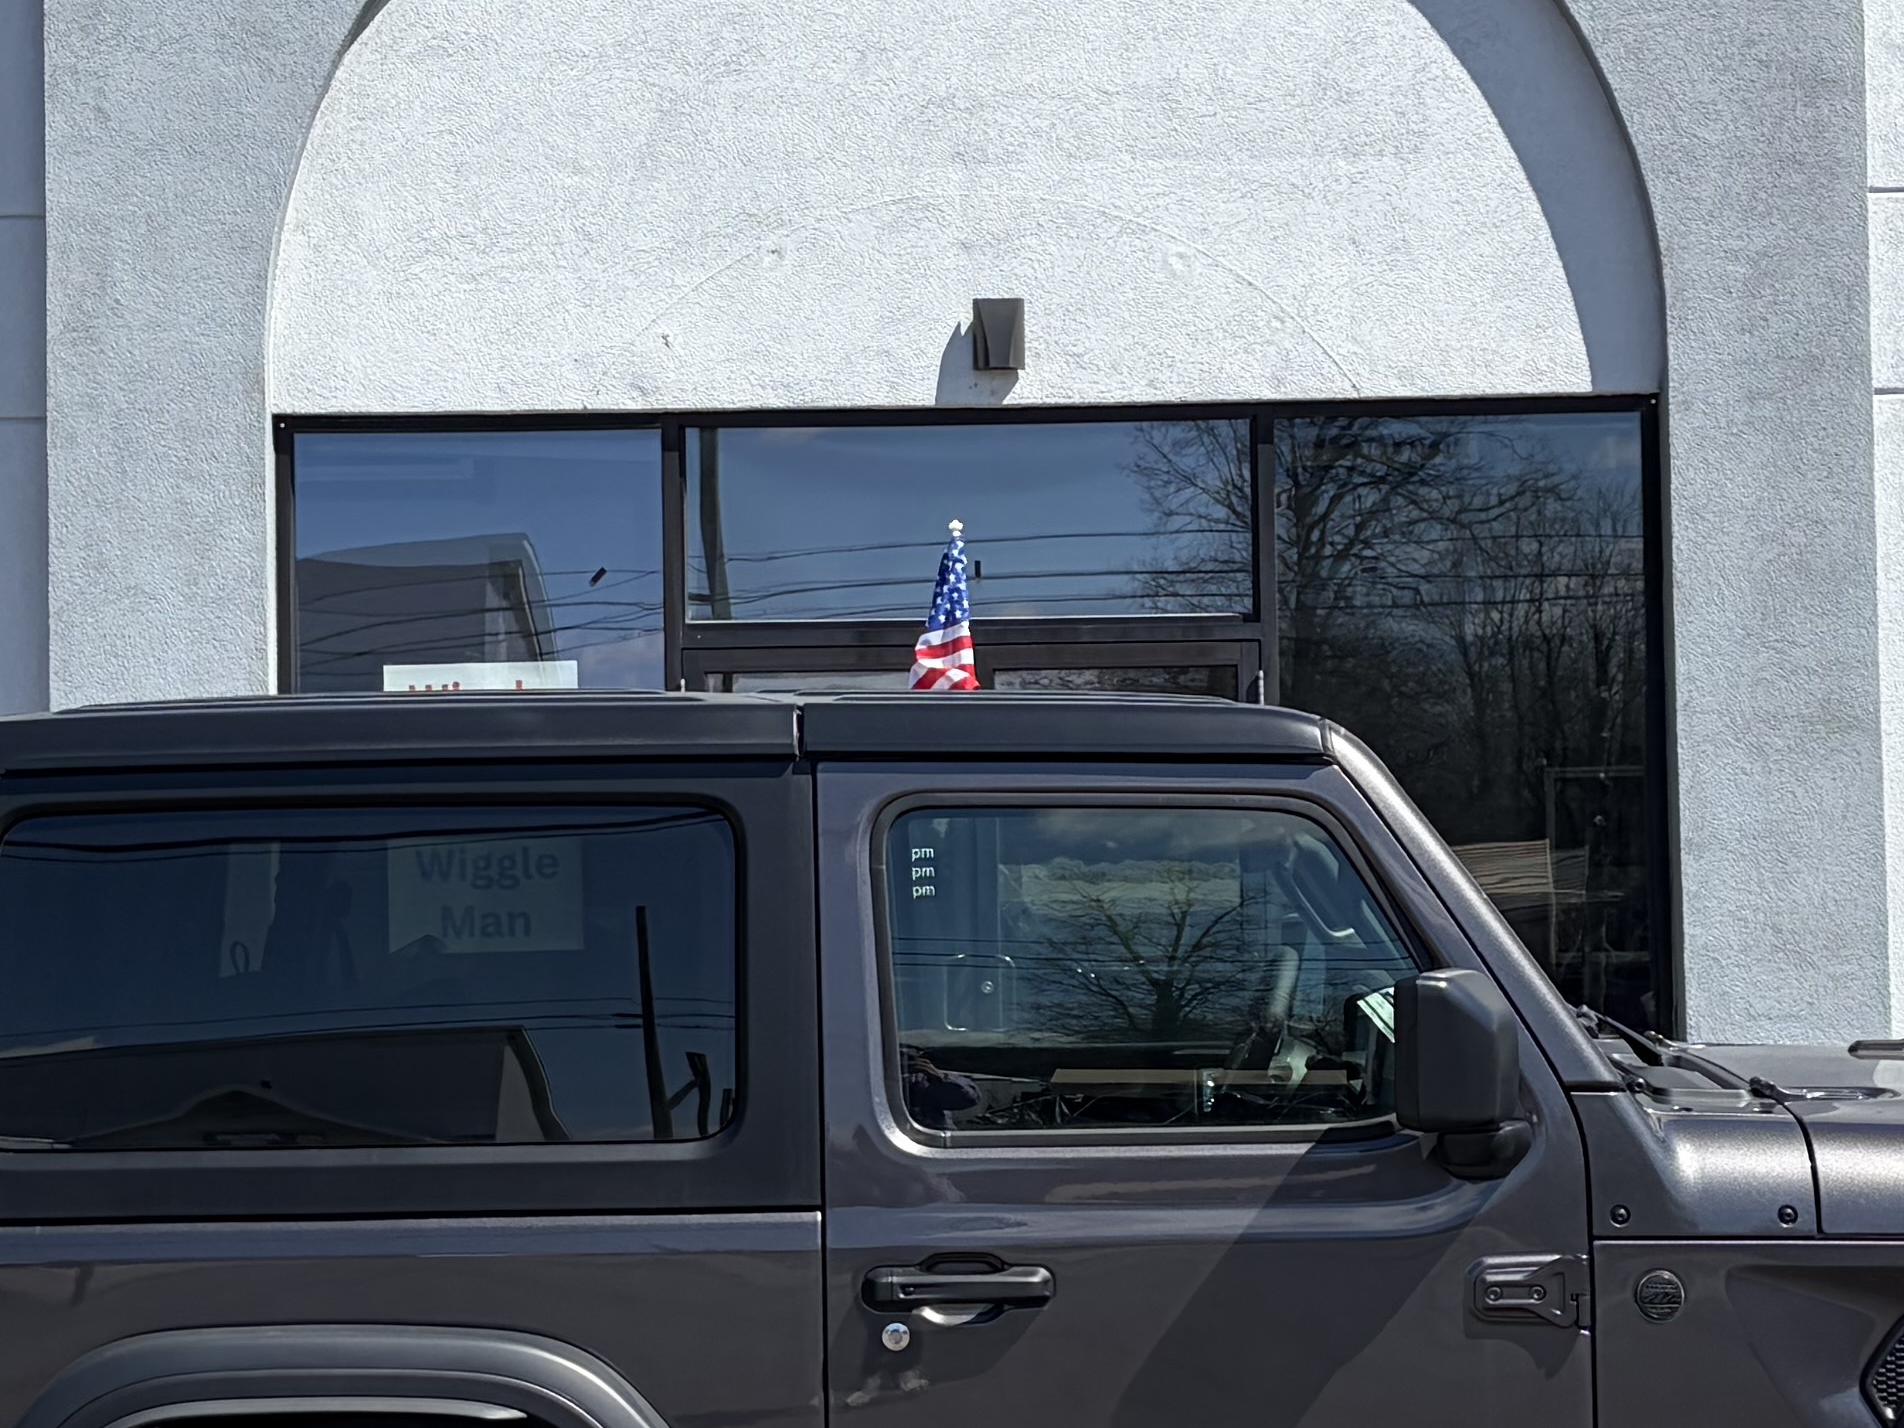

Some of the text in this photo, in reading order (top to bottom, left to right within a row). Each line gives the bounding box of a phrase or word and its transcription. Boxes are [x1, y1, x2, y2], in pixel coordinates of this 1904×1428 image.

[911, 848, 934, 862] pm
[415, 845, 560, 890] Wiggle
[911, 866, 935, 881] pm
[912, 885, 936, 900] pm
[441, 904, 532, 939] Man
